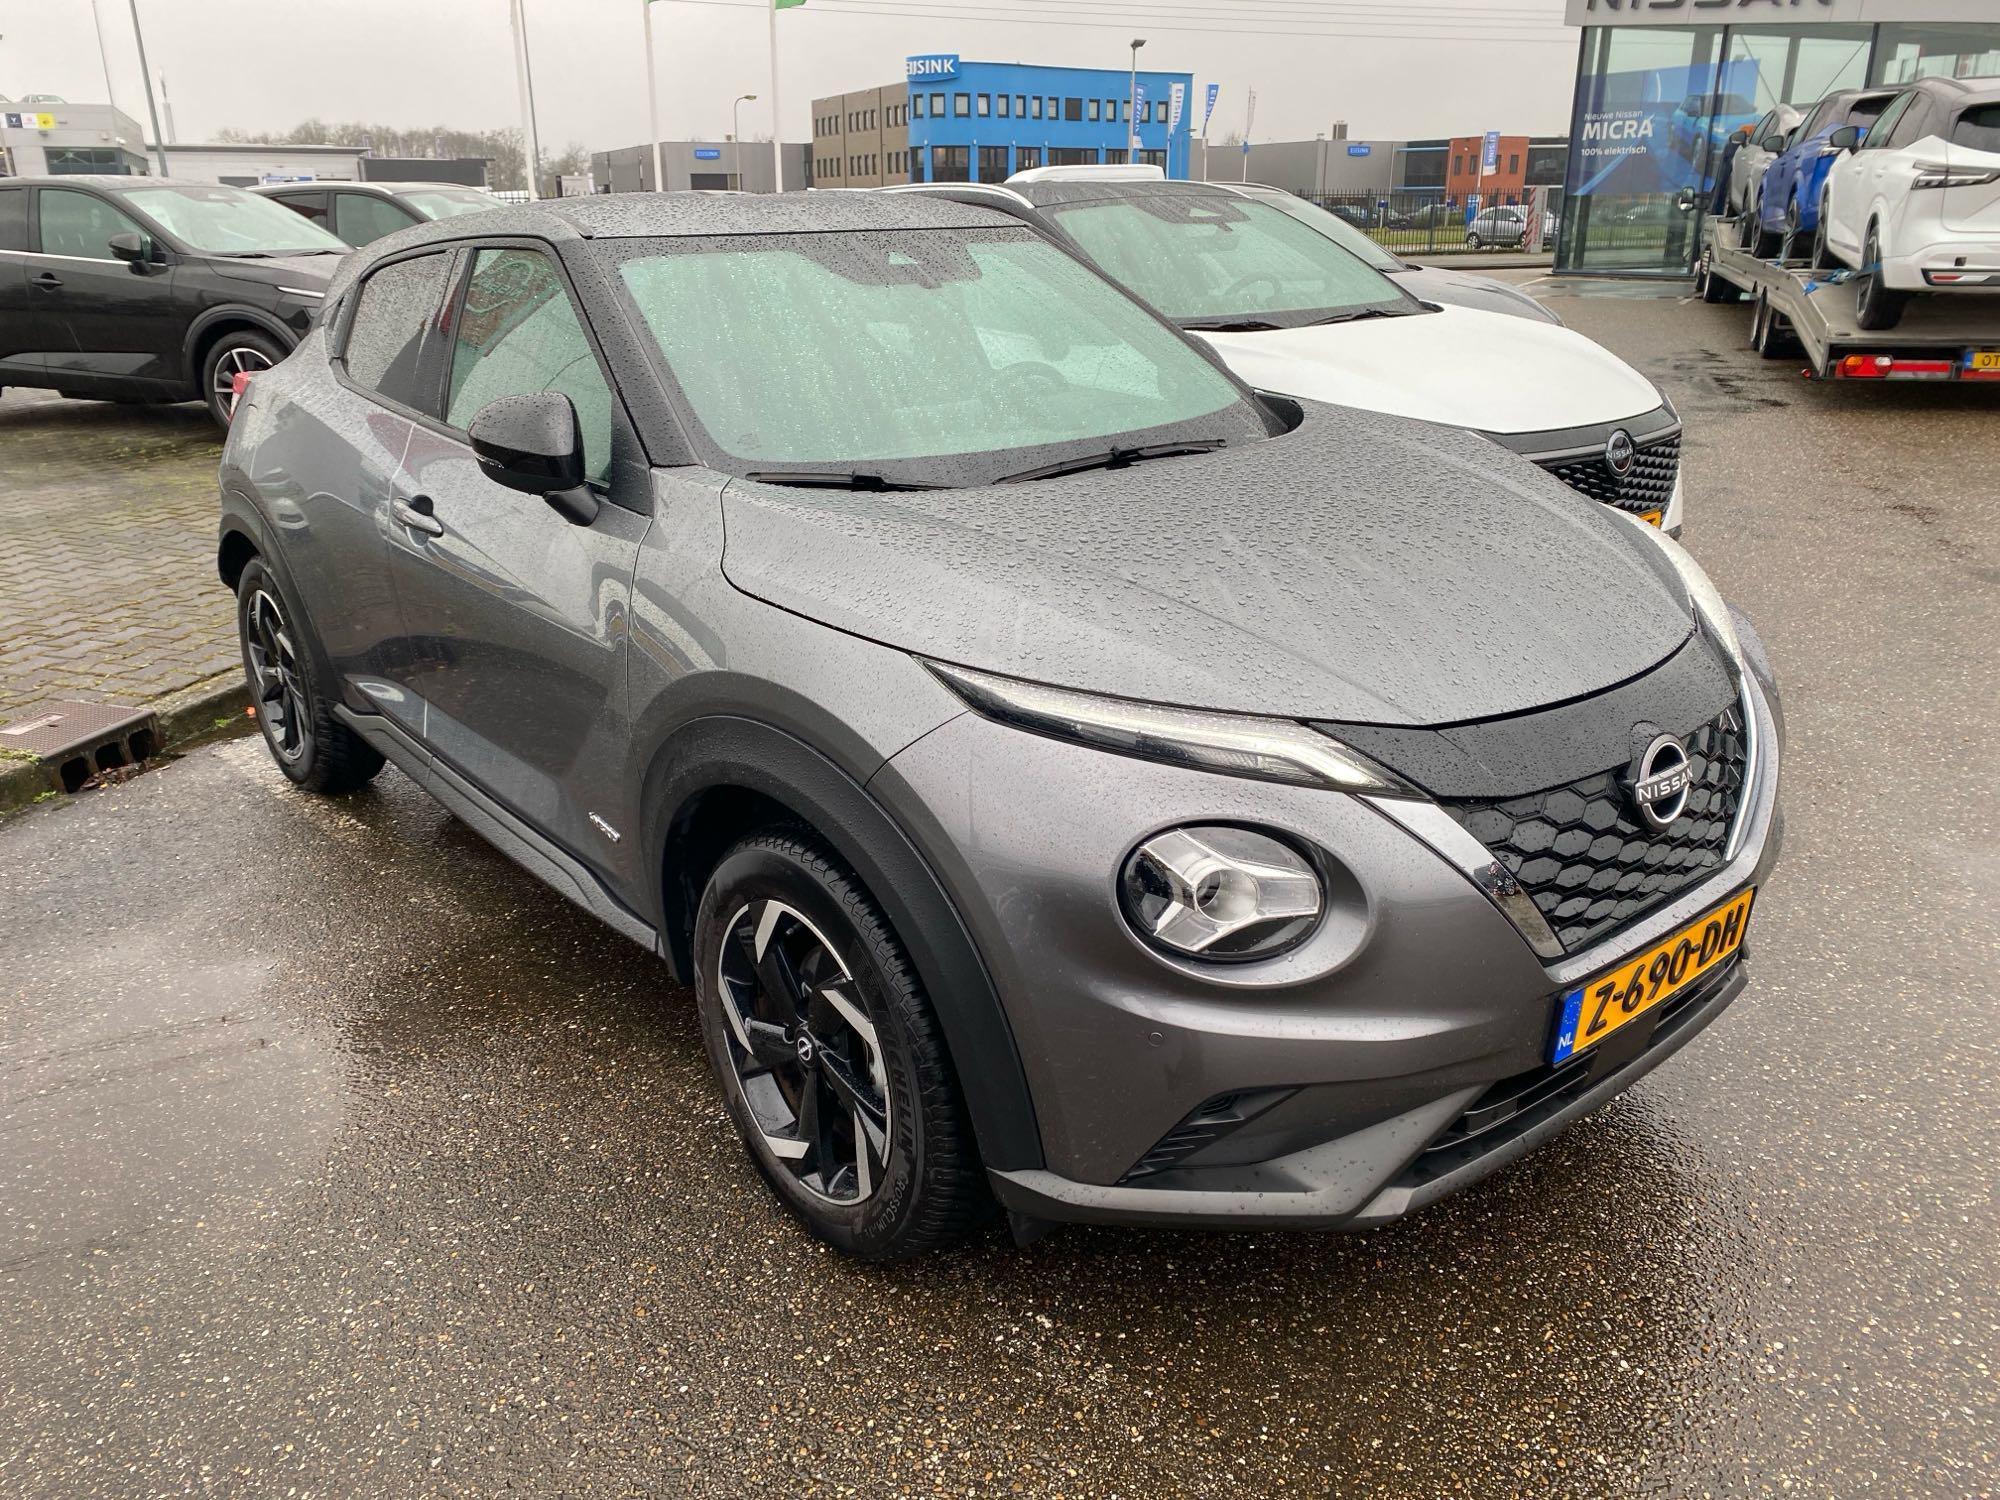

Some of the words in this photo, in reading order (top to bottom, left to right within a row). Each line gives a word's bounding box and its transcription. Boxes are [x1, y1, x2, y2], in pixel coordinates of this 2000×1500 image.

[1584, 112, 1614, 120] Nieuwe
[1615, 110, 1643, 118] Nissan
[1582, 119, 1654, 140] MICRA
[1581, 147, 1603, 156] 100%
[1604, 145, 1647, 155] elektrisch
[1606, 447, 1633, 459] NISSAN
[1638, 765, 1694, 802] NISSAN
[1585, 902, 1745, 1037] Z-690-DH
[1558, 1032, 1573, 1050] NL
